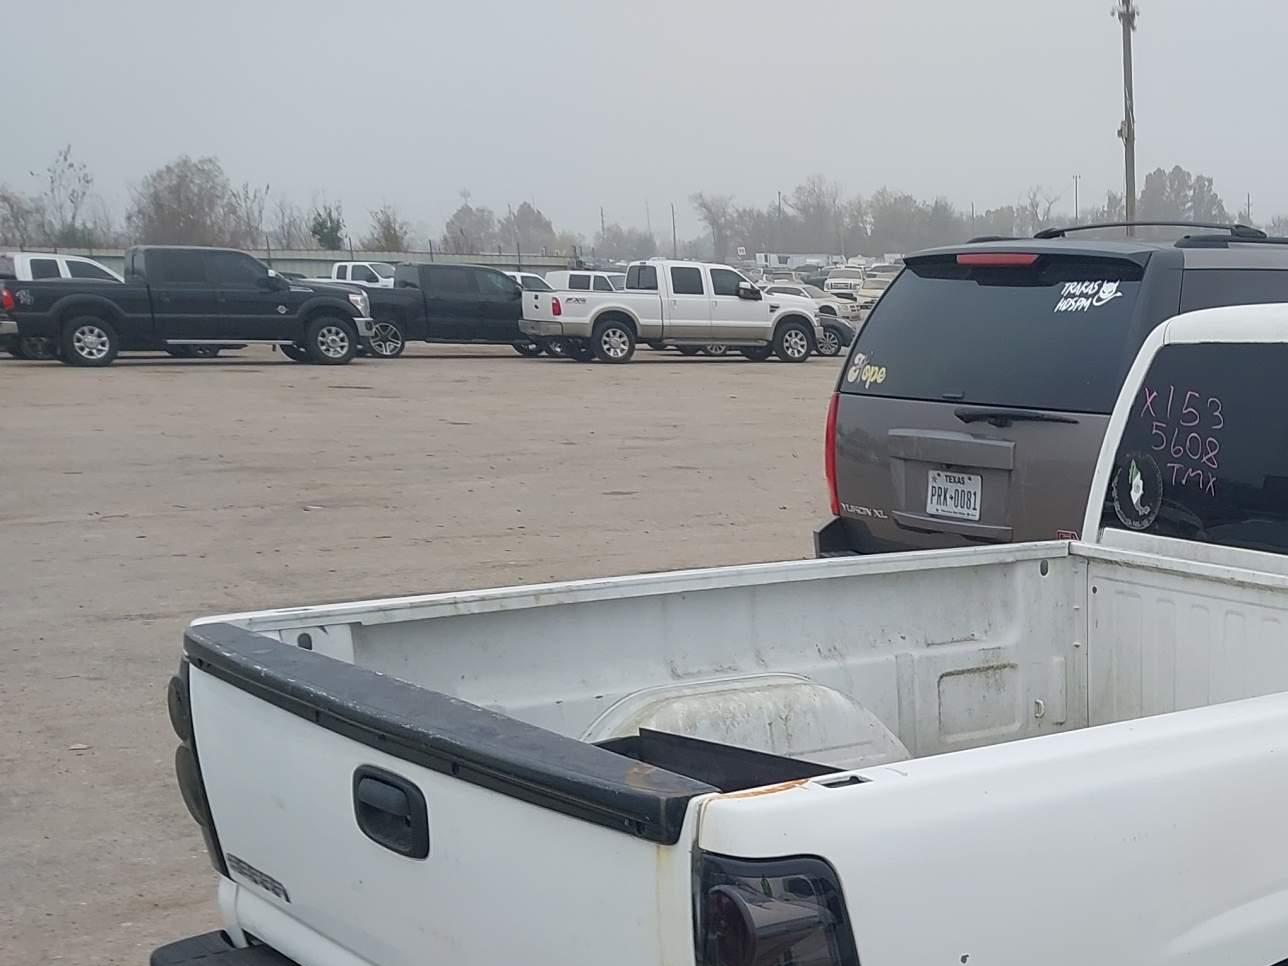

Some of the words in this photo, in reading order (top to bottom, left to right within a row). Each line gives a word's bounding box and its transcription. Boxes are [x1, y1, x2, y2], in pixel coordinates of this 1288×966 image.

[1151, 421, 1220, 469] 5608
[944, 474, 966, 486] TEXAS
[1166, 463, 1217, 497] TMX
[872, 508, 888, 519] XL
